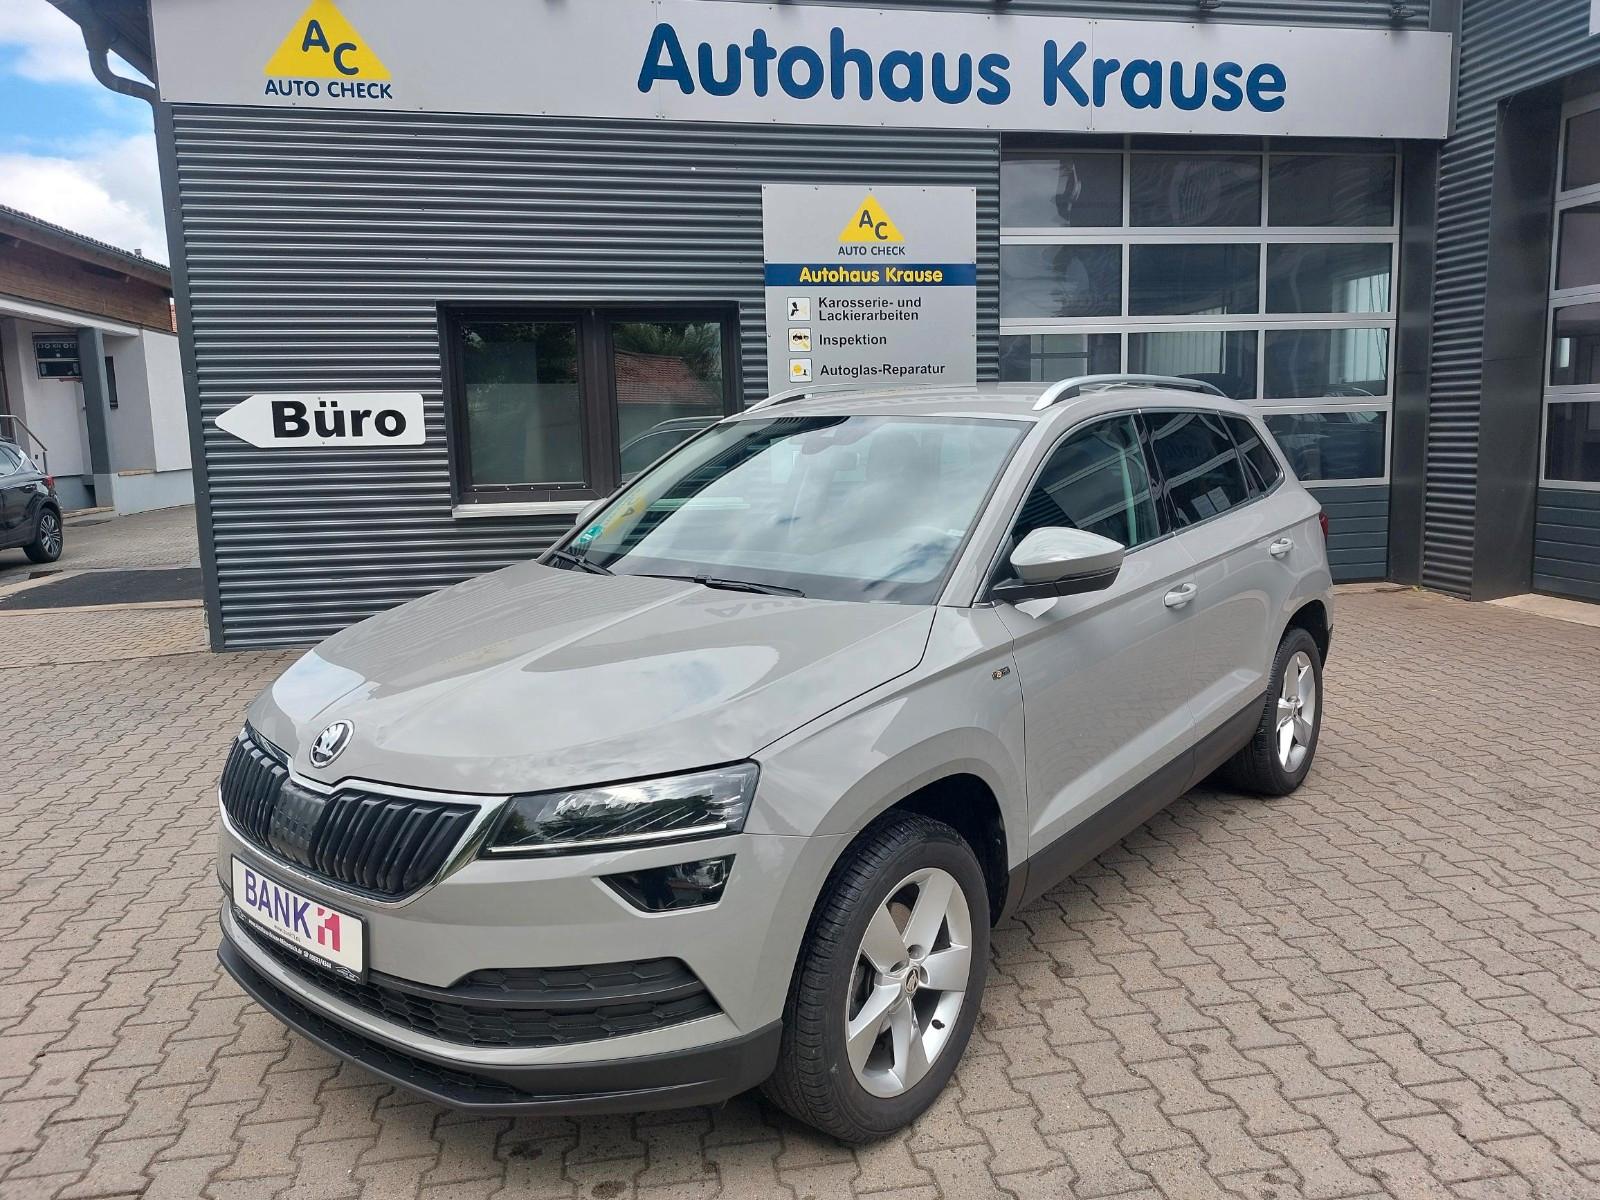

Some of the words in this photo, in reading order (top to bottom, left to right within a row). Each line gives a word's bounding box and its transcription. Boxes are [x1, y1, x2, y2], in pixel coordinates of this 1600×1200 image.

[637, 22, 1011, 105] Autohaus
[1043, 39, 1287, 112] Krause
[264, 79, 320, 97] AUTO
[327, 81, 393, 99] CHECK
[838, 246, 867, 256] AUTO
[870, 246, 906, 256] CHECK
[799, 266, 880, 283] Autohaus
[885, 266, 943, 283] Krause
[818, 297, 894, 308] Karosserie-
[897, 297, 922, 308] und
[818, 309, 919, 321] Lackierarbeiten
[819, 334, 887, 348] Inspektion
[820, 364, 946, 379] Autoglas-Reparatur
[271, 400, 407, 438] Büro
[245, 868, 312, 940] BANK
